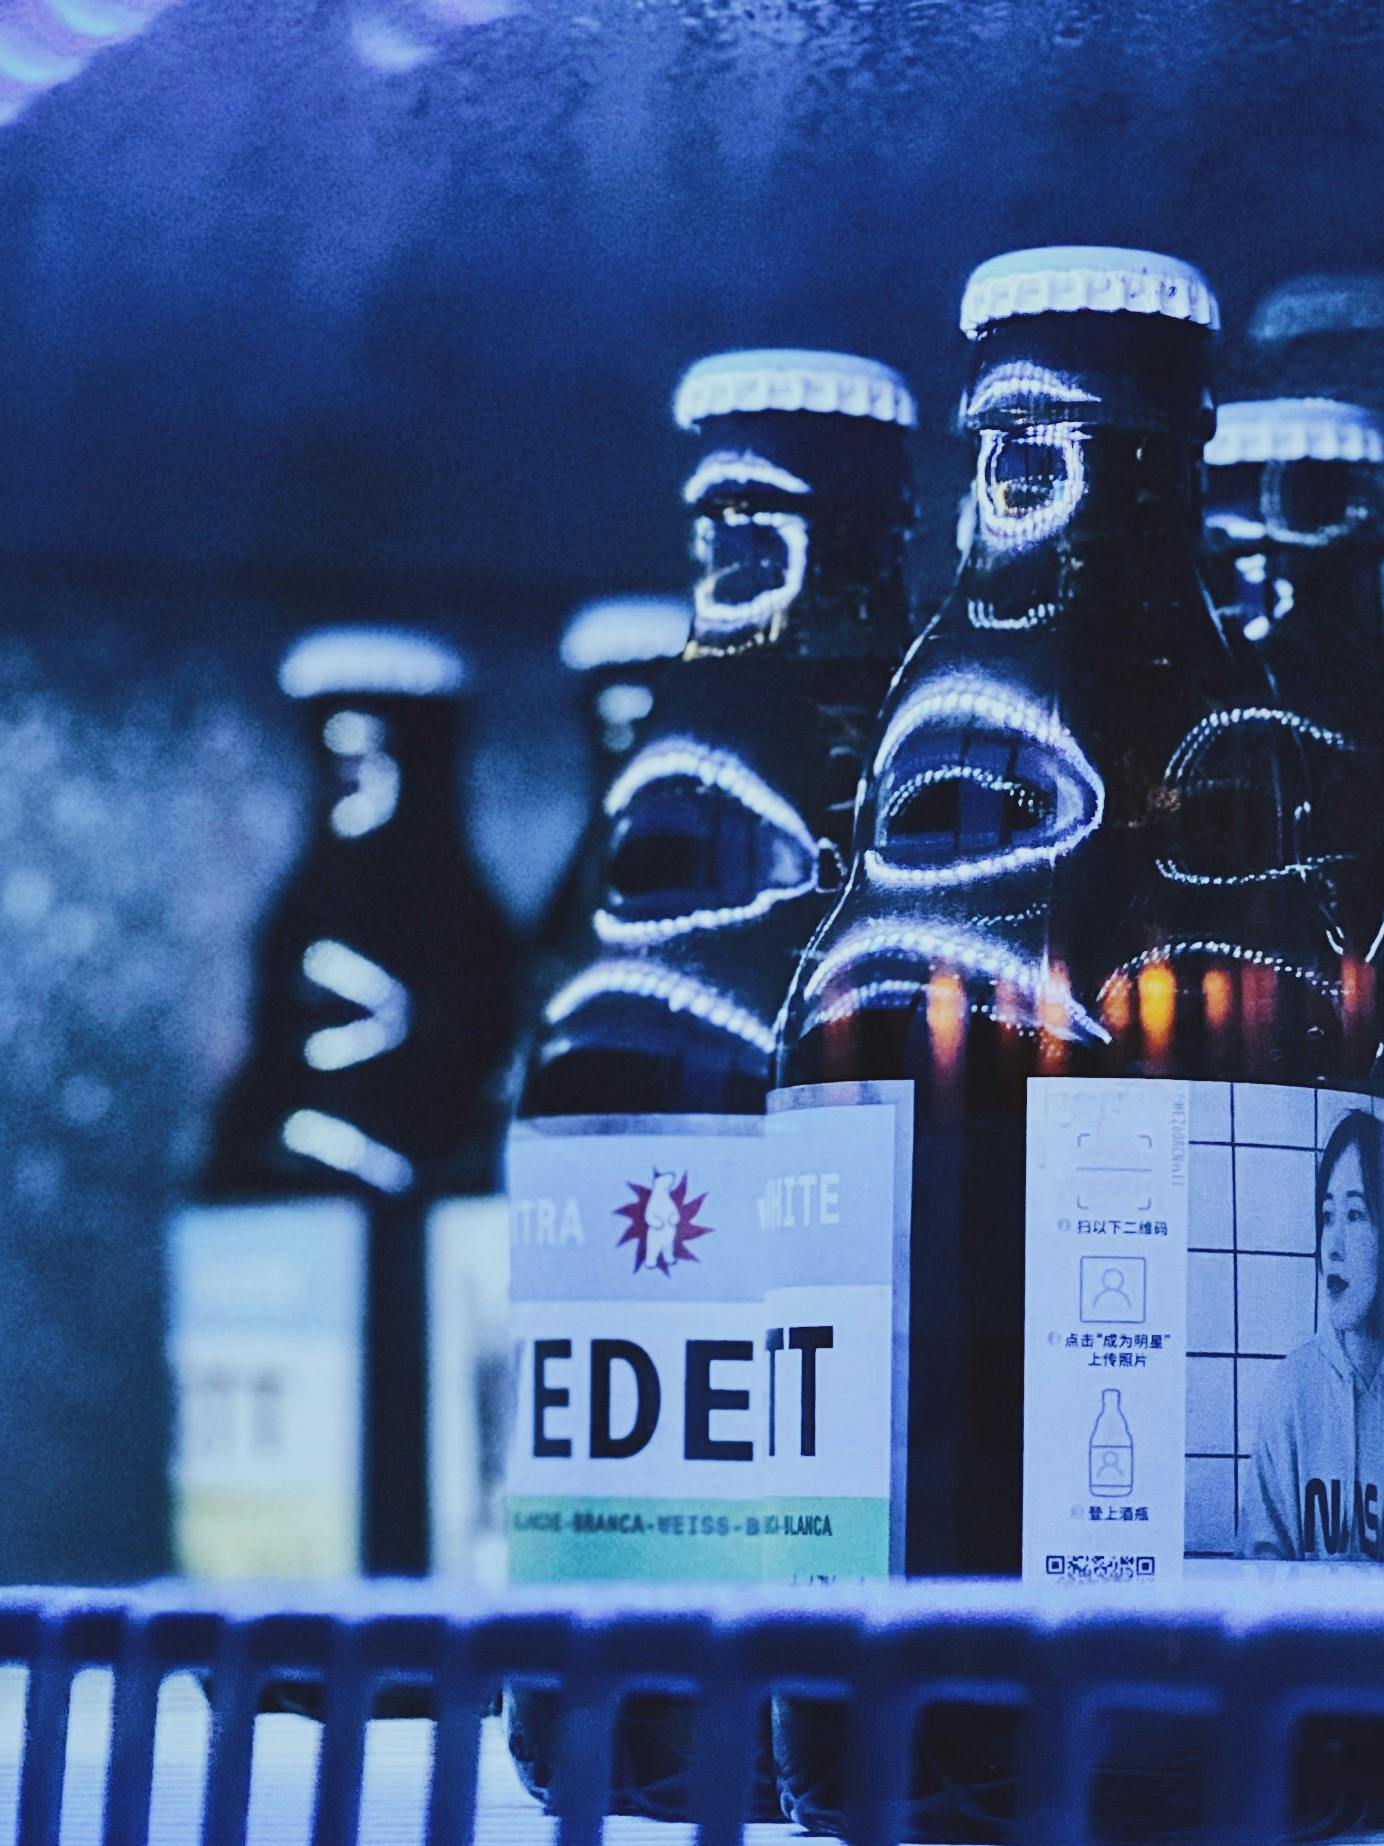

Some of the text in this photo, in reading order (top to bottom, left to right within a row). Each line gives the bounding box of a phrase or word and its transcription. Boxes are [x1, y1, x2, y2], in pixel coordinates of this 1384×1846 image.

[512, 1196, 585, 1247] TRA
[1087, 1352, 1148, 1368] 上传照片
